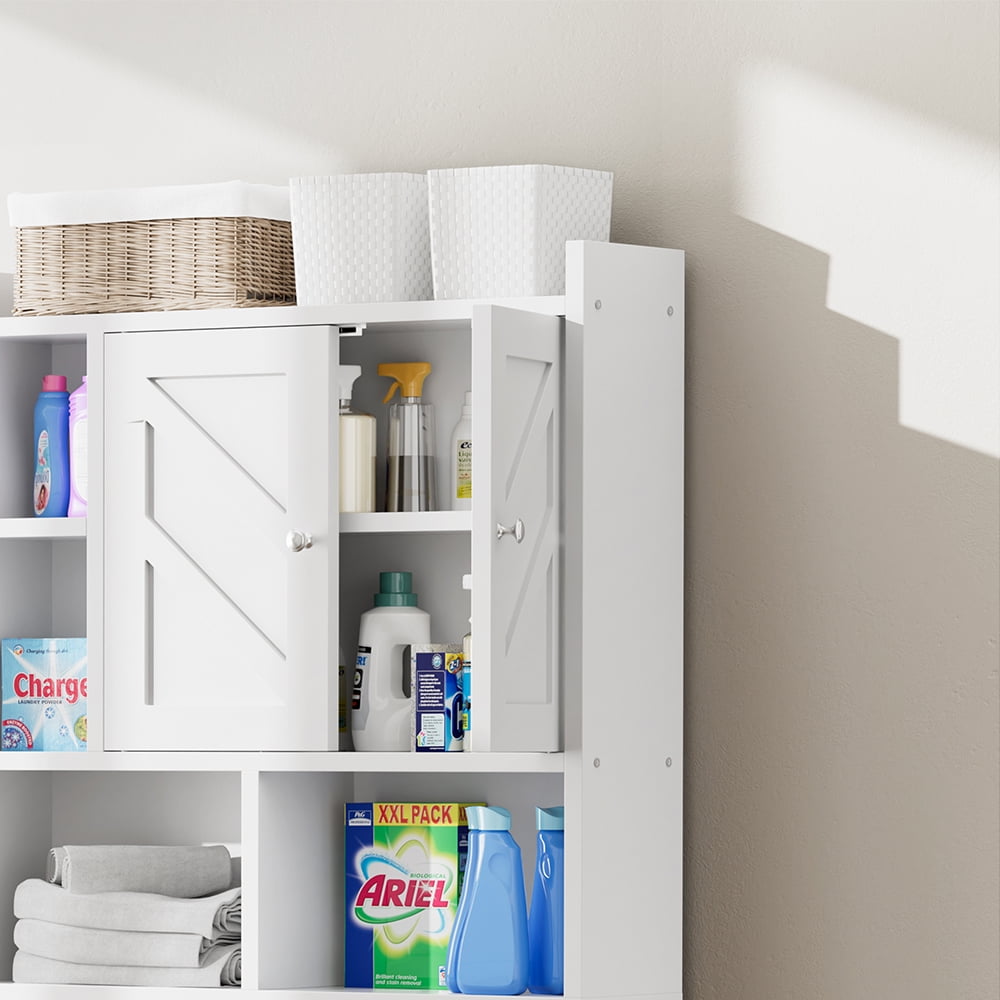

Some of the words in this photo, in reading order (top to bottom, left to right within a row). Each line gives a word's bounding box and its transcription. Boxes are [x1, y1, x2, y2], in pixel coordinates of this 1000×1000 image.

[378, 804, 408, 824] XXL
[411, 804, 453, 824] PACK
[355, 874, 449, 908] ARIEL
